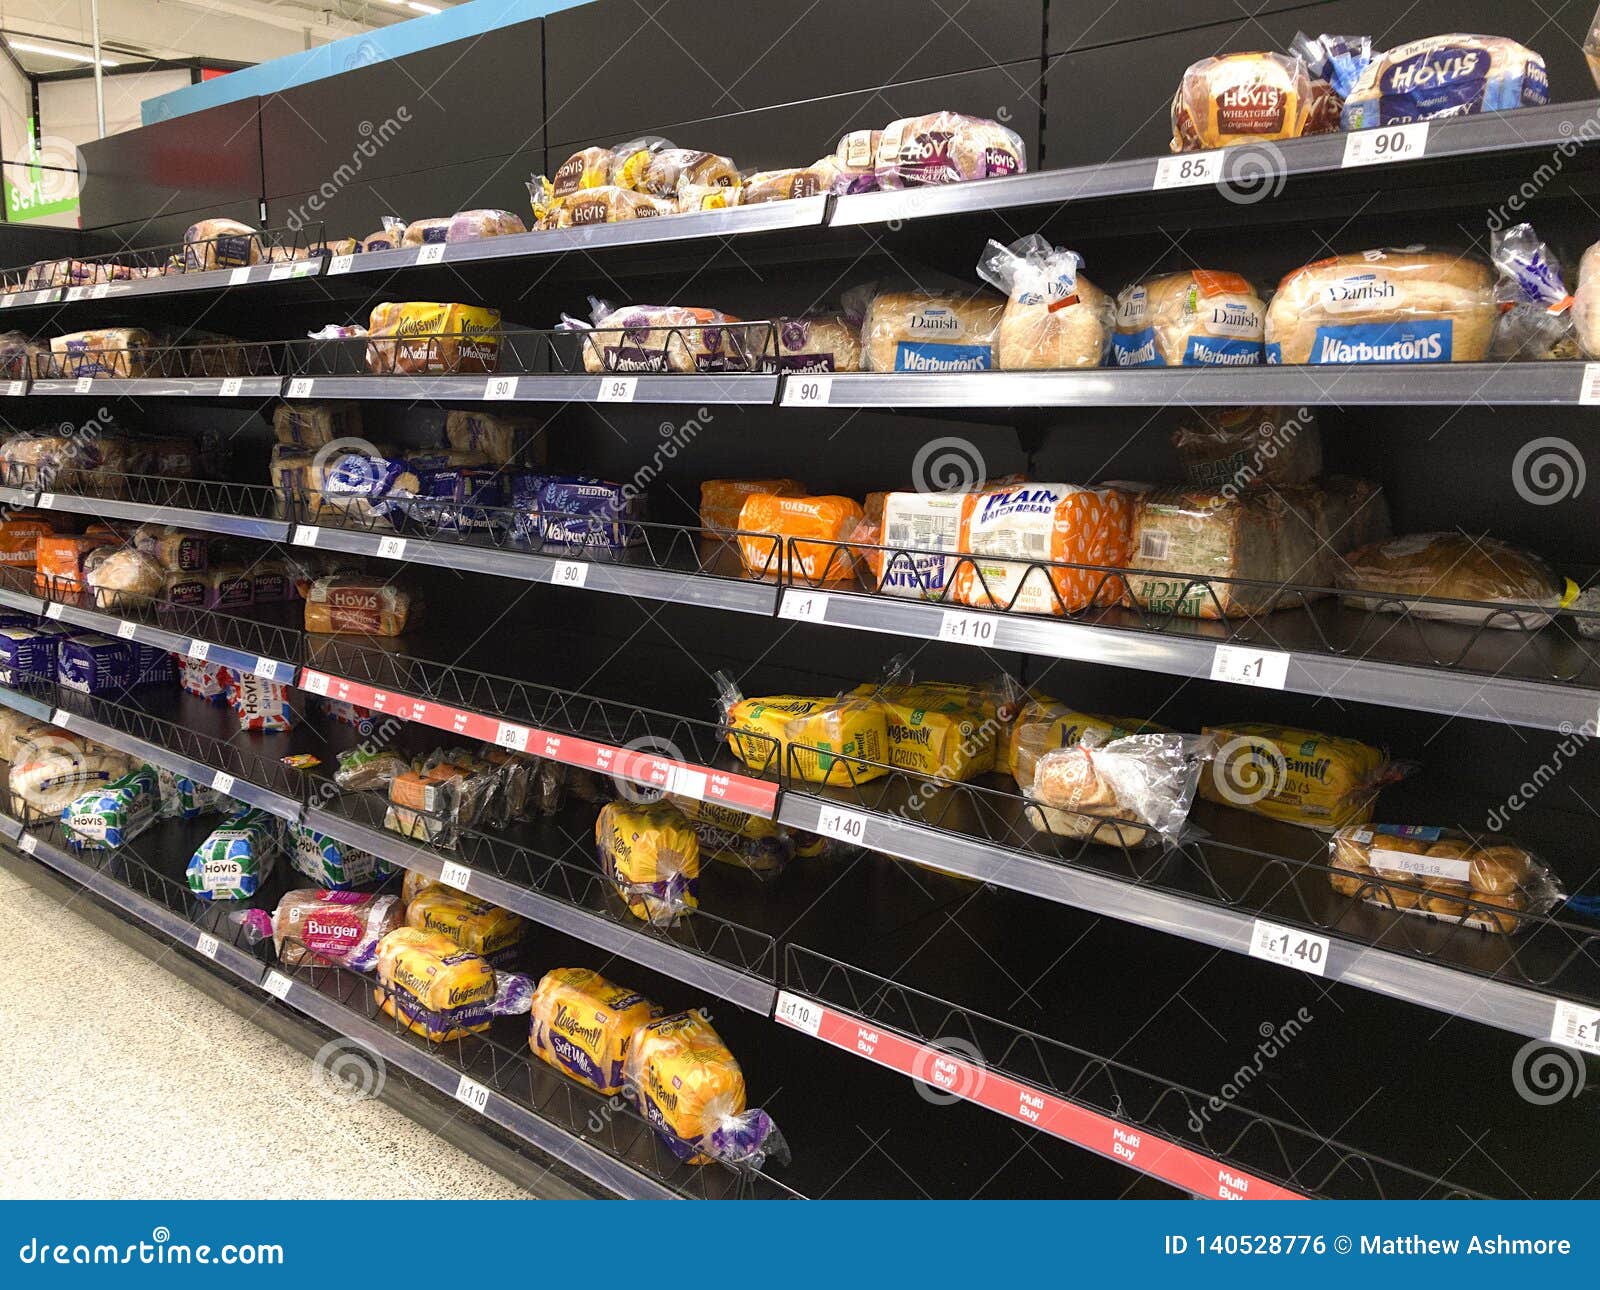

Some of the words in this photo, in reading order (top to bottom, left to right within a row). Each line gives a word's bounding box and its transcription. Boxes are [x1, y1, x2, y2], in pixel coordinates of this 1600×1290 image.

[1391, 51, 1479, 89] HOVIS
[1224, 91, 1279, 109] HOVIS
[1222, 108, 1280, 120] WHEATGERM
[558, 159, 583, 178] HOVIS
[986, 152, 1014, 169] HOVIS
[793, 177, 804, 199] OVIS
[575, 205, 605, 222] HOVIS
[1329, 280, 1395, 301] Danish
[911, 315, 958, 331] Danish
[1213, 308, 1259, 328] Danish
[1193, 342, 1260, 365] Warburtons
[1321, 333, 1441, 363] Warburtons
[904, 348, 984, 371] Warburtons
[577, 487, 616, 498] MEDIUM
[985, 490, 1059, 511] PLAIN
[981, 504, 1013, 524] BATCH
[1014, 503, 1052, 515] BREAD
[255, 575, 282, 585] HOVIS
[886, 567, 945, 590] PLAIN
[173, 585, 202, 595] HOVIS
[335, 593, 377, 608] HOVIS
[1243, 657, 1265, 678] £1
[546, 737, 560, 747] Multi
[888, 725, 932, 751] ngsmill
[597, 748, 613, 759] Multi
[894, 751, 928, 770] CRUSTS
[596, 758, 609, 769] Buy
[711, 774, 728, 786] Multi
[711, 786, 726, 797] Buy
[73, 817, 103, 826] HOVIS
[205, 864, 238, 873] HOVIS
[308, 920, 358, 938] Burgen
[1268, 934, 1323, 963] £1.40
[554, 1002, 603, 1051] Kingsmill
[858, 1027, 878, 1044] Multi
[554, 1037, 572, 1059] Soft
[857, 1041, 874, 1056] Buy
[935, 1057, 957, 1075] Multi
[934, 1071, 953, 1086] Buy
[1019, 1091, 1045, 1109] Multi
[1019, 1105, 1040, 1122] Buy
[1113, 1128, 1140, 1148] Multi
[1113, 1143, 1136, 1161] Buy
[1218, 1170, 1248, 1192] Multi
[1218, 1185, 1244, 1200] Buy
